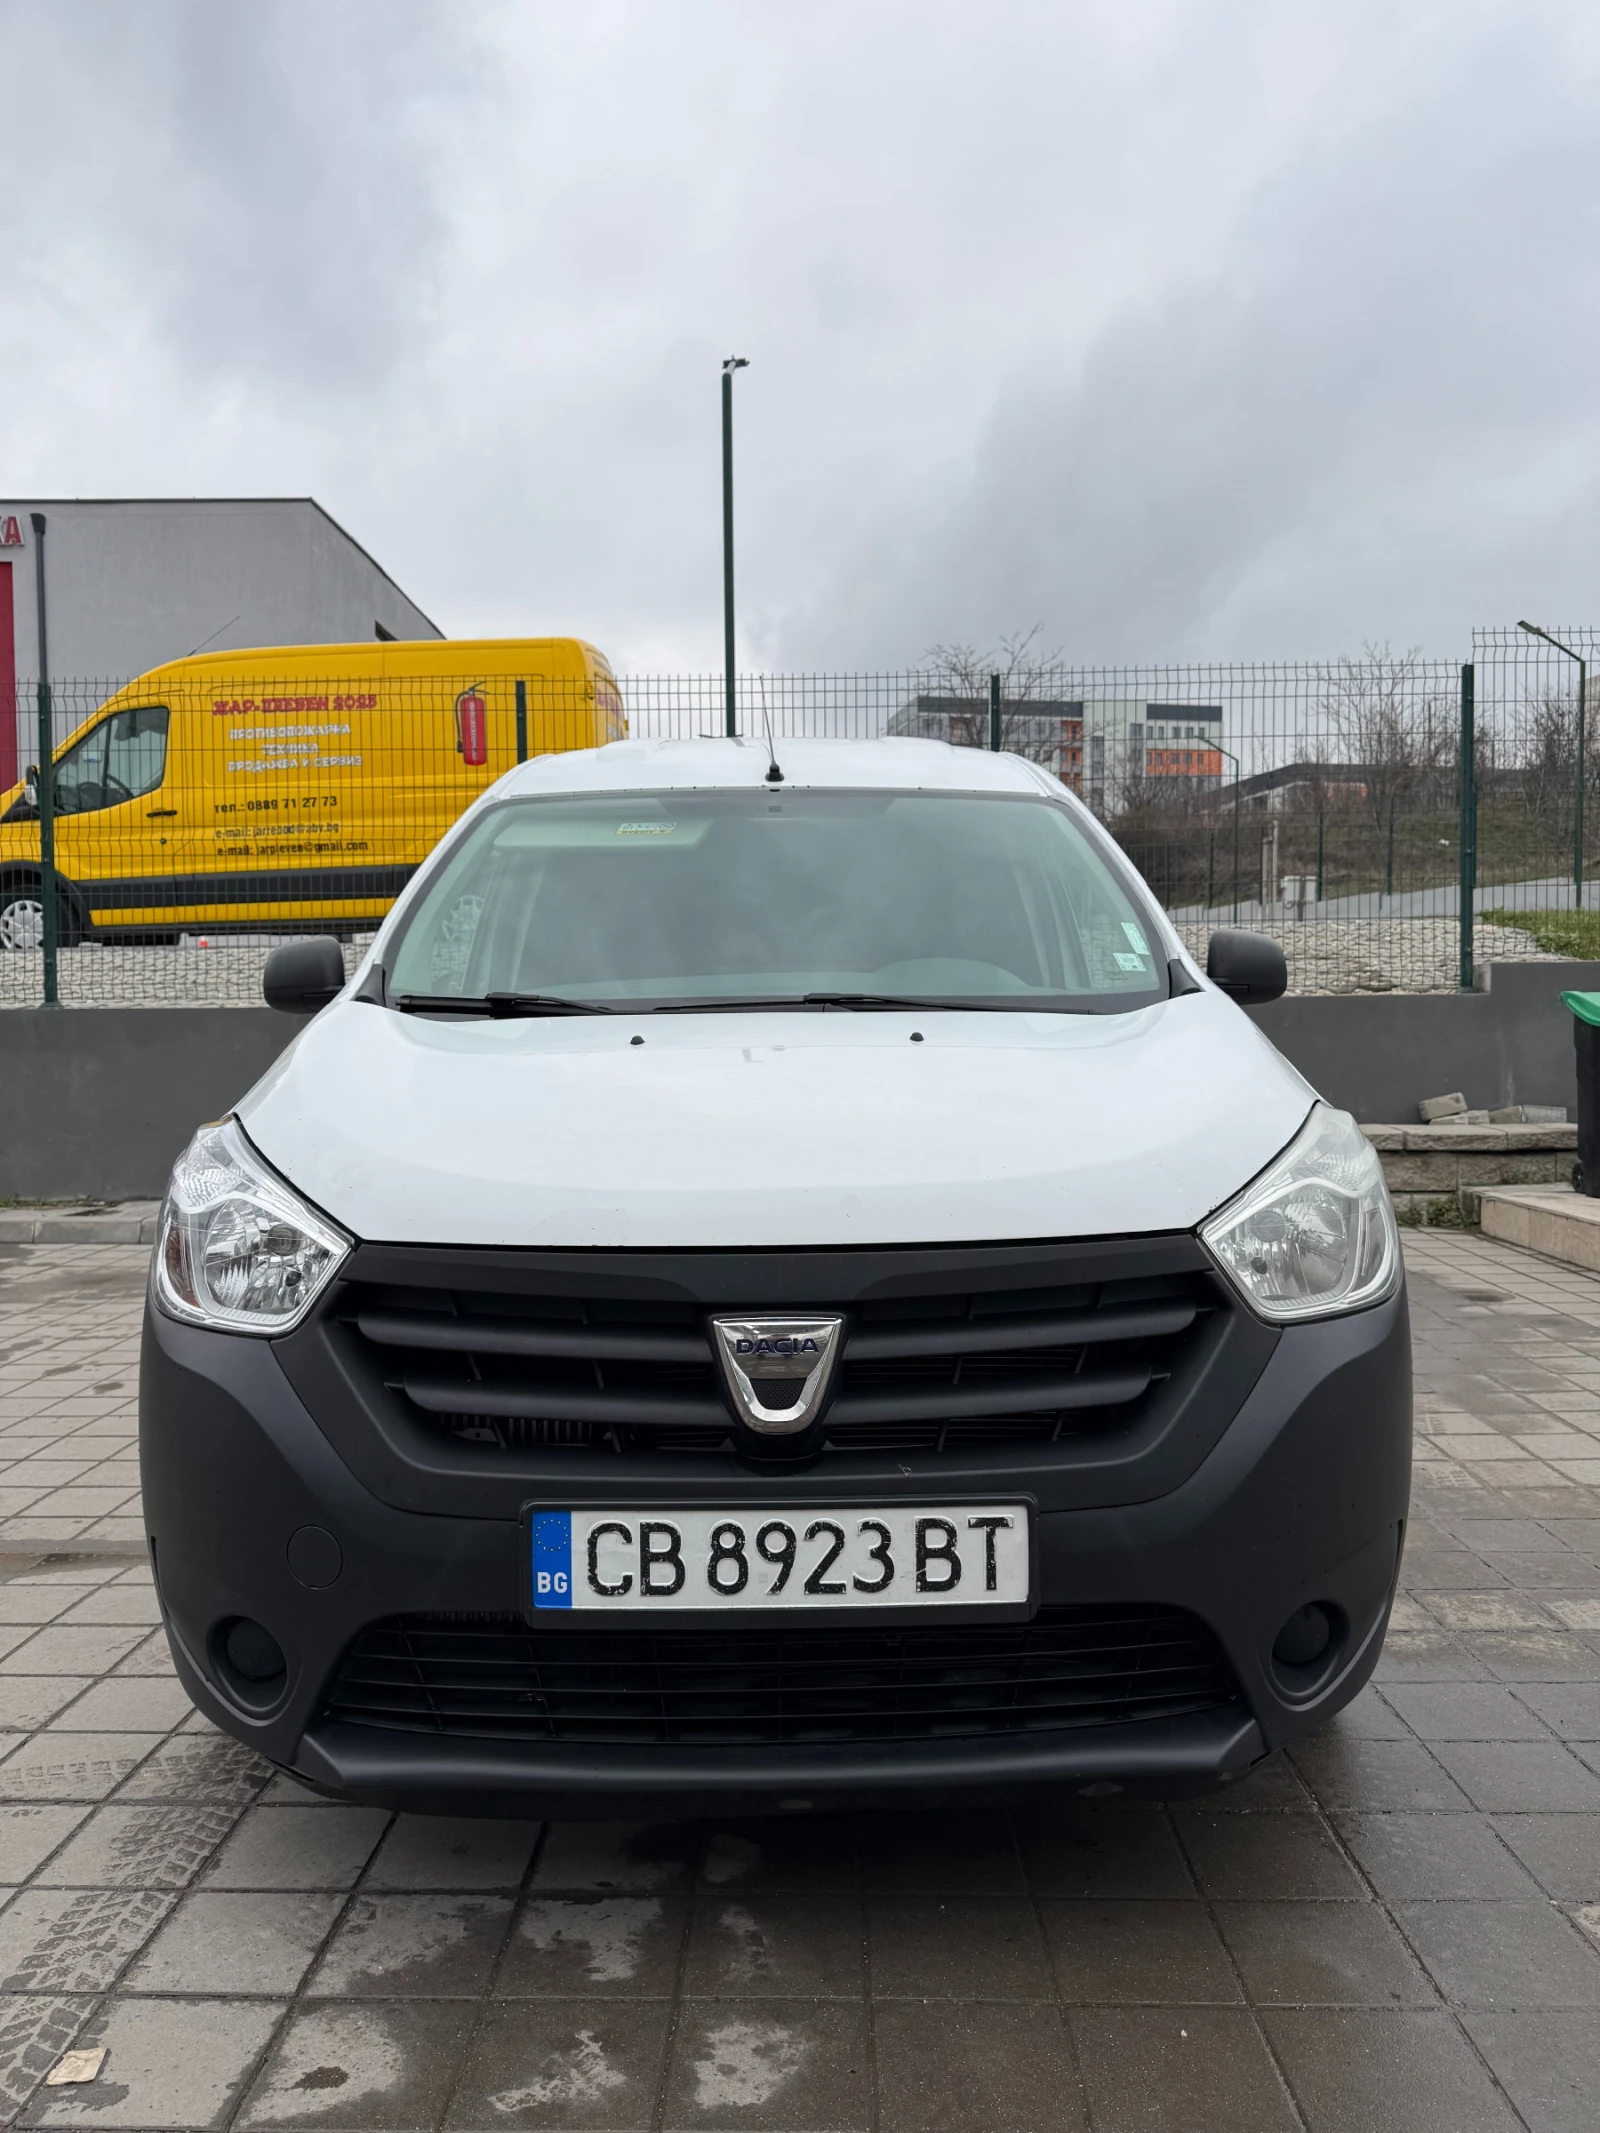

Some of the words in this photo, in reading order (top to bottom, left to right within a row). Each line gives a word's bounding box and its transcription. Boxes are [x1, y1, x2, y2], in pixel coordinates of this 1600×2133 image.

[229, 724, 351, 740] ПРОТИВОПОЖАРНА
[261, 743, 320, 756] ТЕХНИКА
[228, 759, 298, 773] ПРОДАЖБА
[302, 758, 311, 767] И
[314, 756, 363, 768] СЕРВИЗ
[247, 799, 278, 811] 0889
[283, 798, 297, 809] 71
[302, 797, 317, 808] 27
[322, 796, 338, 806] 73
[215, 827, 251, 839] e-mail:
[217, 845, 254, 856] e-mail:
[735, 1338, 819, 1355] DACIA
[537, 1572, 568, 1594] BG
[587, 1520, 686, 1597] CB
[706, 1518, 895, 1596] 8923
[914, 1515, 1014, 1593] BT
